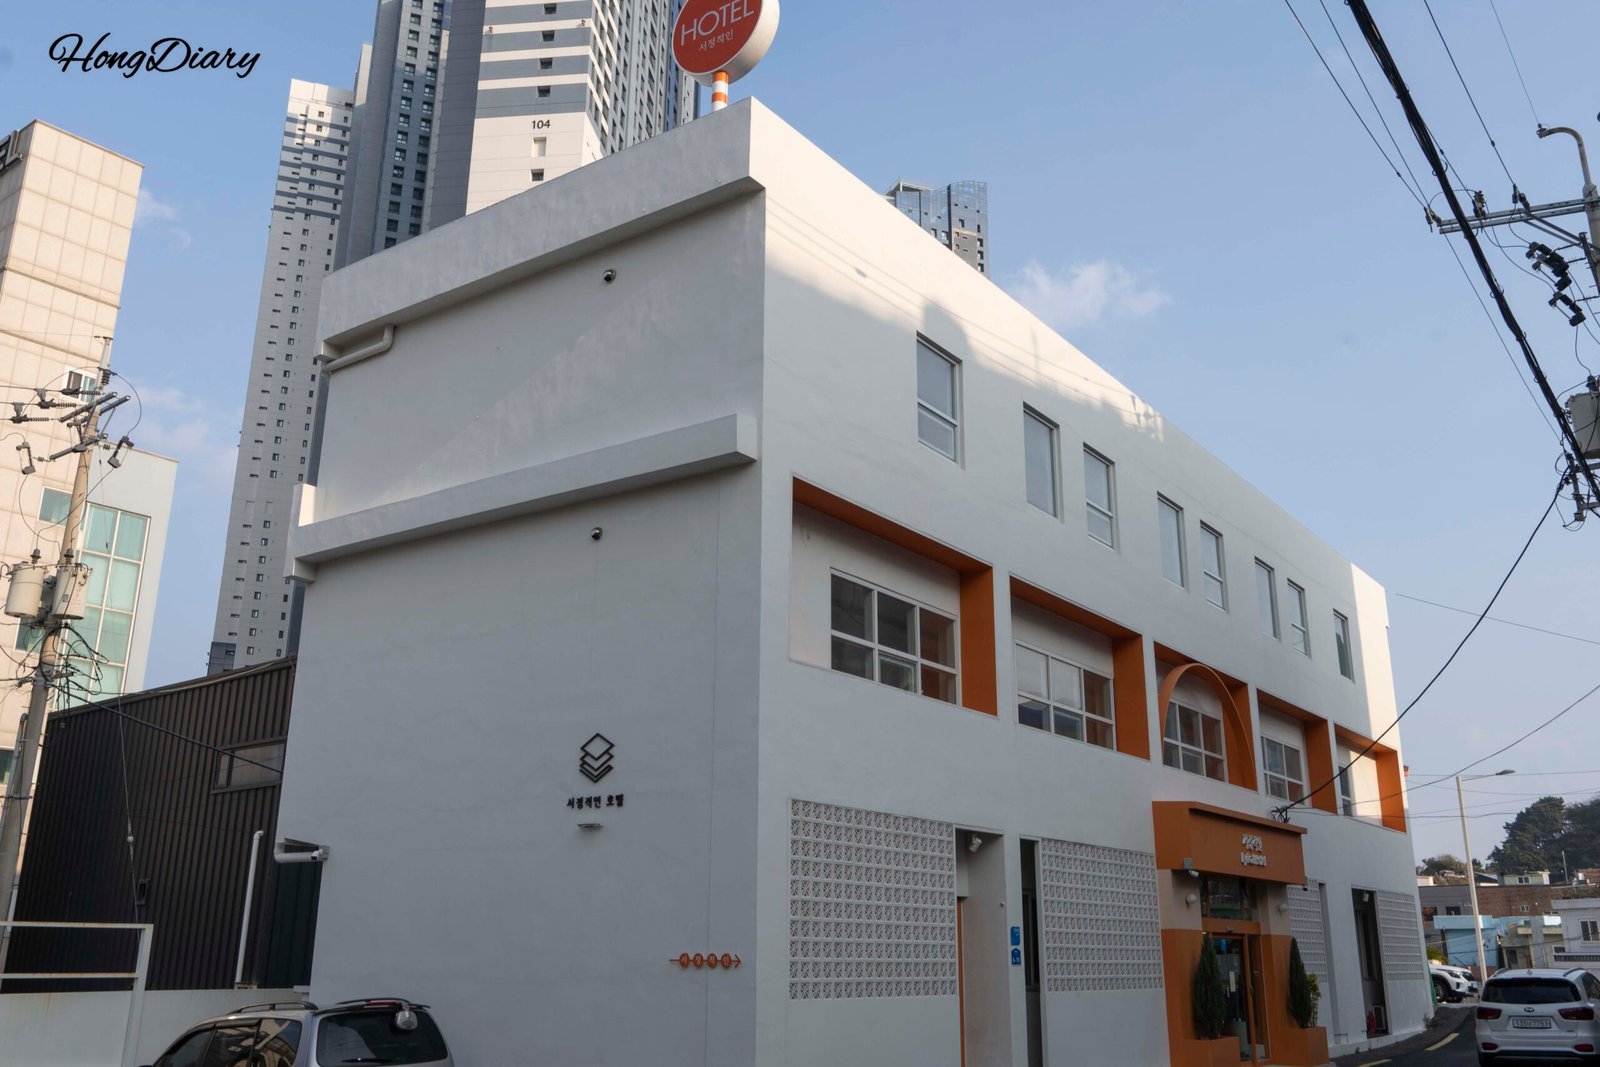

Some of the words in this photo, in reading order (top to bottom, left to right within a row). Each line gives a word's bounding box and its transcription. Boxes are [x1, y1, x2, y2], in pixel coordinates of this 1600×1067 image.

[680, 0, 755, 46] HOTEL
[698, 29, 734, 51] 서정적인
[531, 119, 551, 130] 104
[566, 795, 602, 810] 서정적인
[606, 793, 624, 808] 호텔
